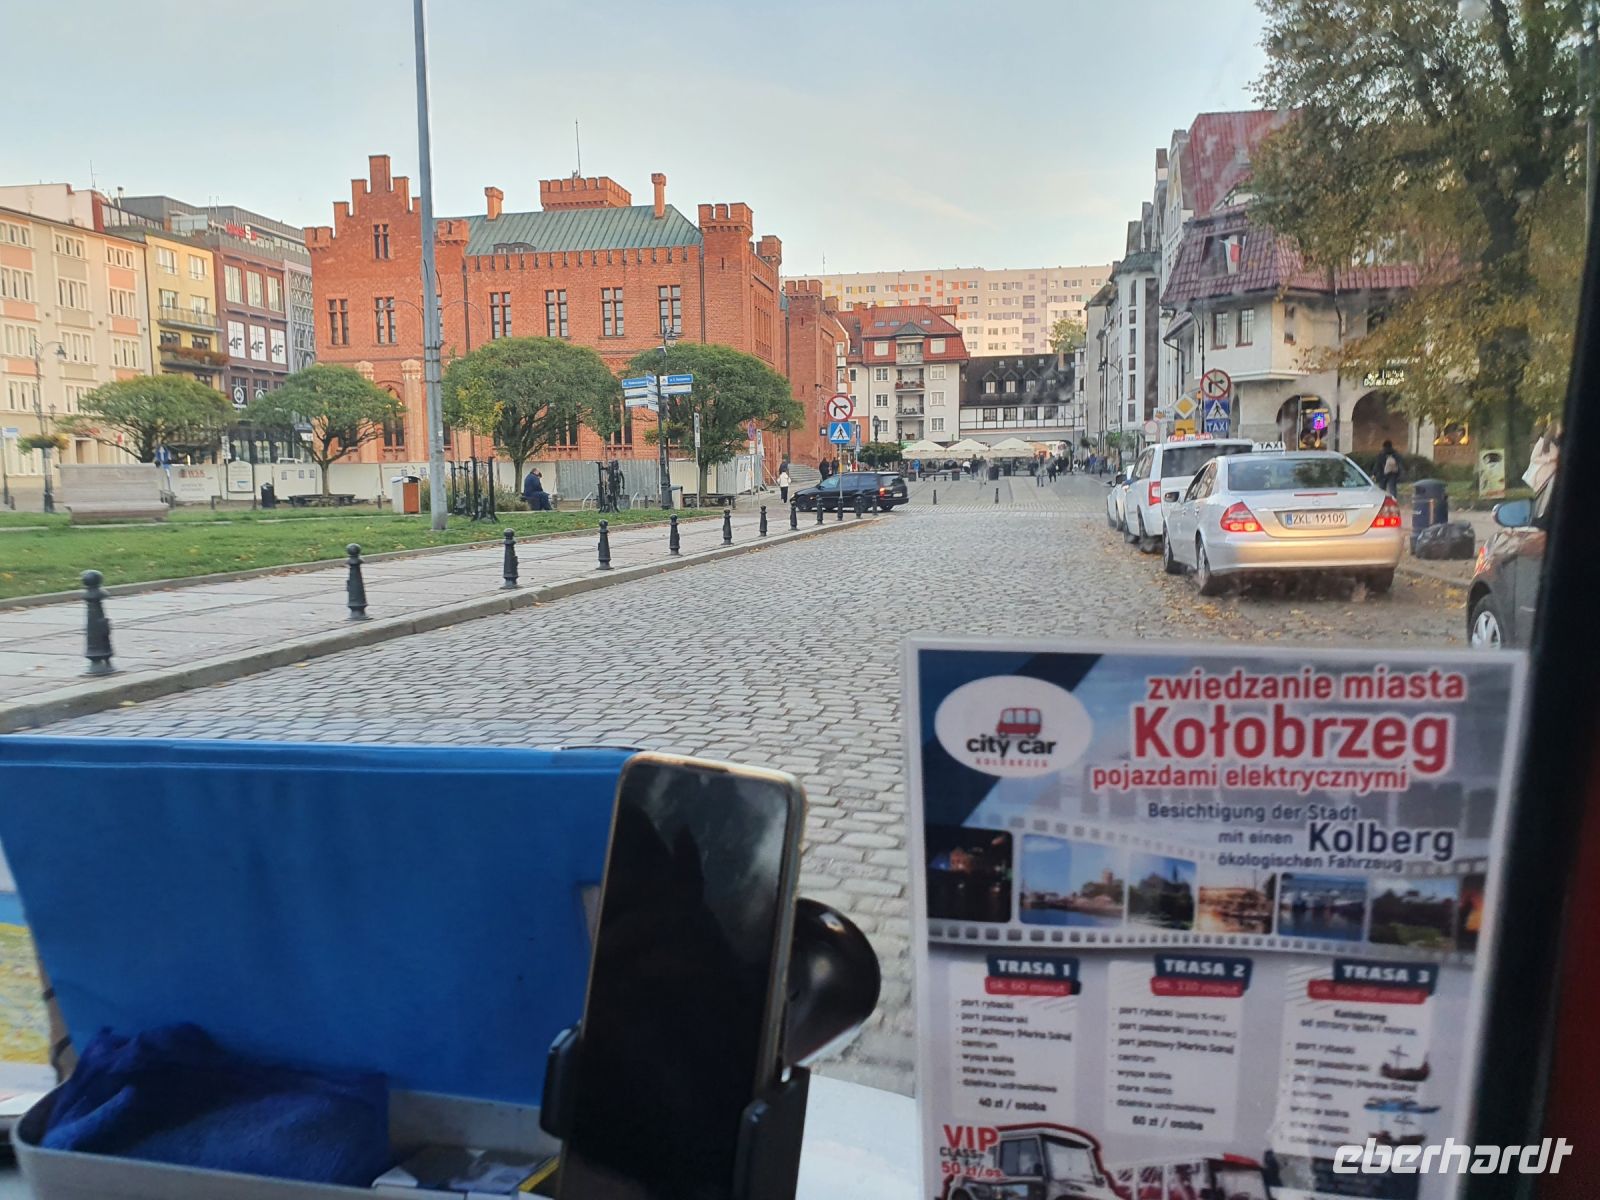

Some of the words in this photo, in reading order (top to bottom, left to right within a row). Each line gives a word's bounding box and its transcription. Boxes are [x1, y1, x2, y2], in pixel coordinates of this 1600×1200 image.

[1206, 421, 1228, 432] TAXI
[1260, 442, 1283, 450] TAXI
[1294, 513, 1312, 524] ZKL
[1316, 513, 1345, 524] 19109
[1148, 668, 1332, 699] zwiedzanie
[1344, 667, 1464, 699] miasta
[966, 734, 1010, 758] city
[1017, 740, 1056, 754] car
[1135, 704, 1448, 773] Kołobrzeg
[1093, 763, 1217, 790] pojazdami
[1226, 764, 1407, 792] elektrycznymi
[1149, 803, 1265, 823] Besichtigung
[1272, 804, 1301, 819] der
[1308, 804, 1358, 820] Stadt
[1218, 830, 1244, 843] mit
[1249, 830, 1293, 844] einen
[1309, 822, 1454, 862] Kolberg
[1218, 852, 1322, 869] ökologischen
[1328, 855, 1403, 872] Fahrzeug
[997, 960, 1056, 976] TRASA
[1062, 963, 1071, 976] 1
[1164, 959, 1226, 976] TRASA
[1233, 964, 1246, 977] 2
[1342, 964, 1410, 982] TRASA
[1417, 970, 1430, 983] 3
[943, 1124, 998, 1152] VIP
[941, 1161, 961, 1174] 50
